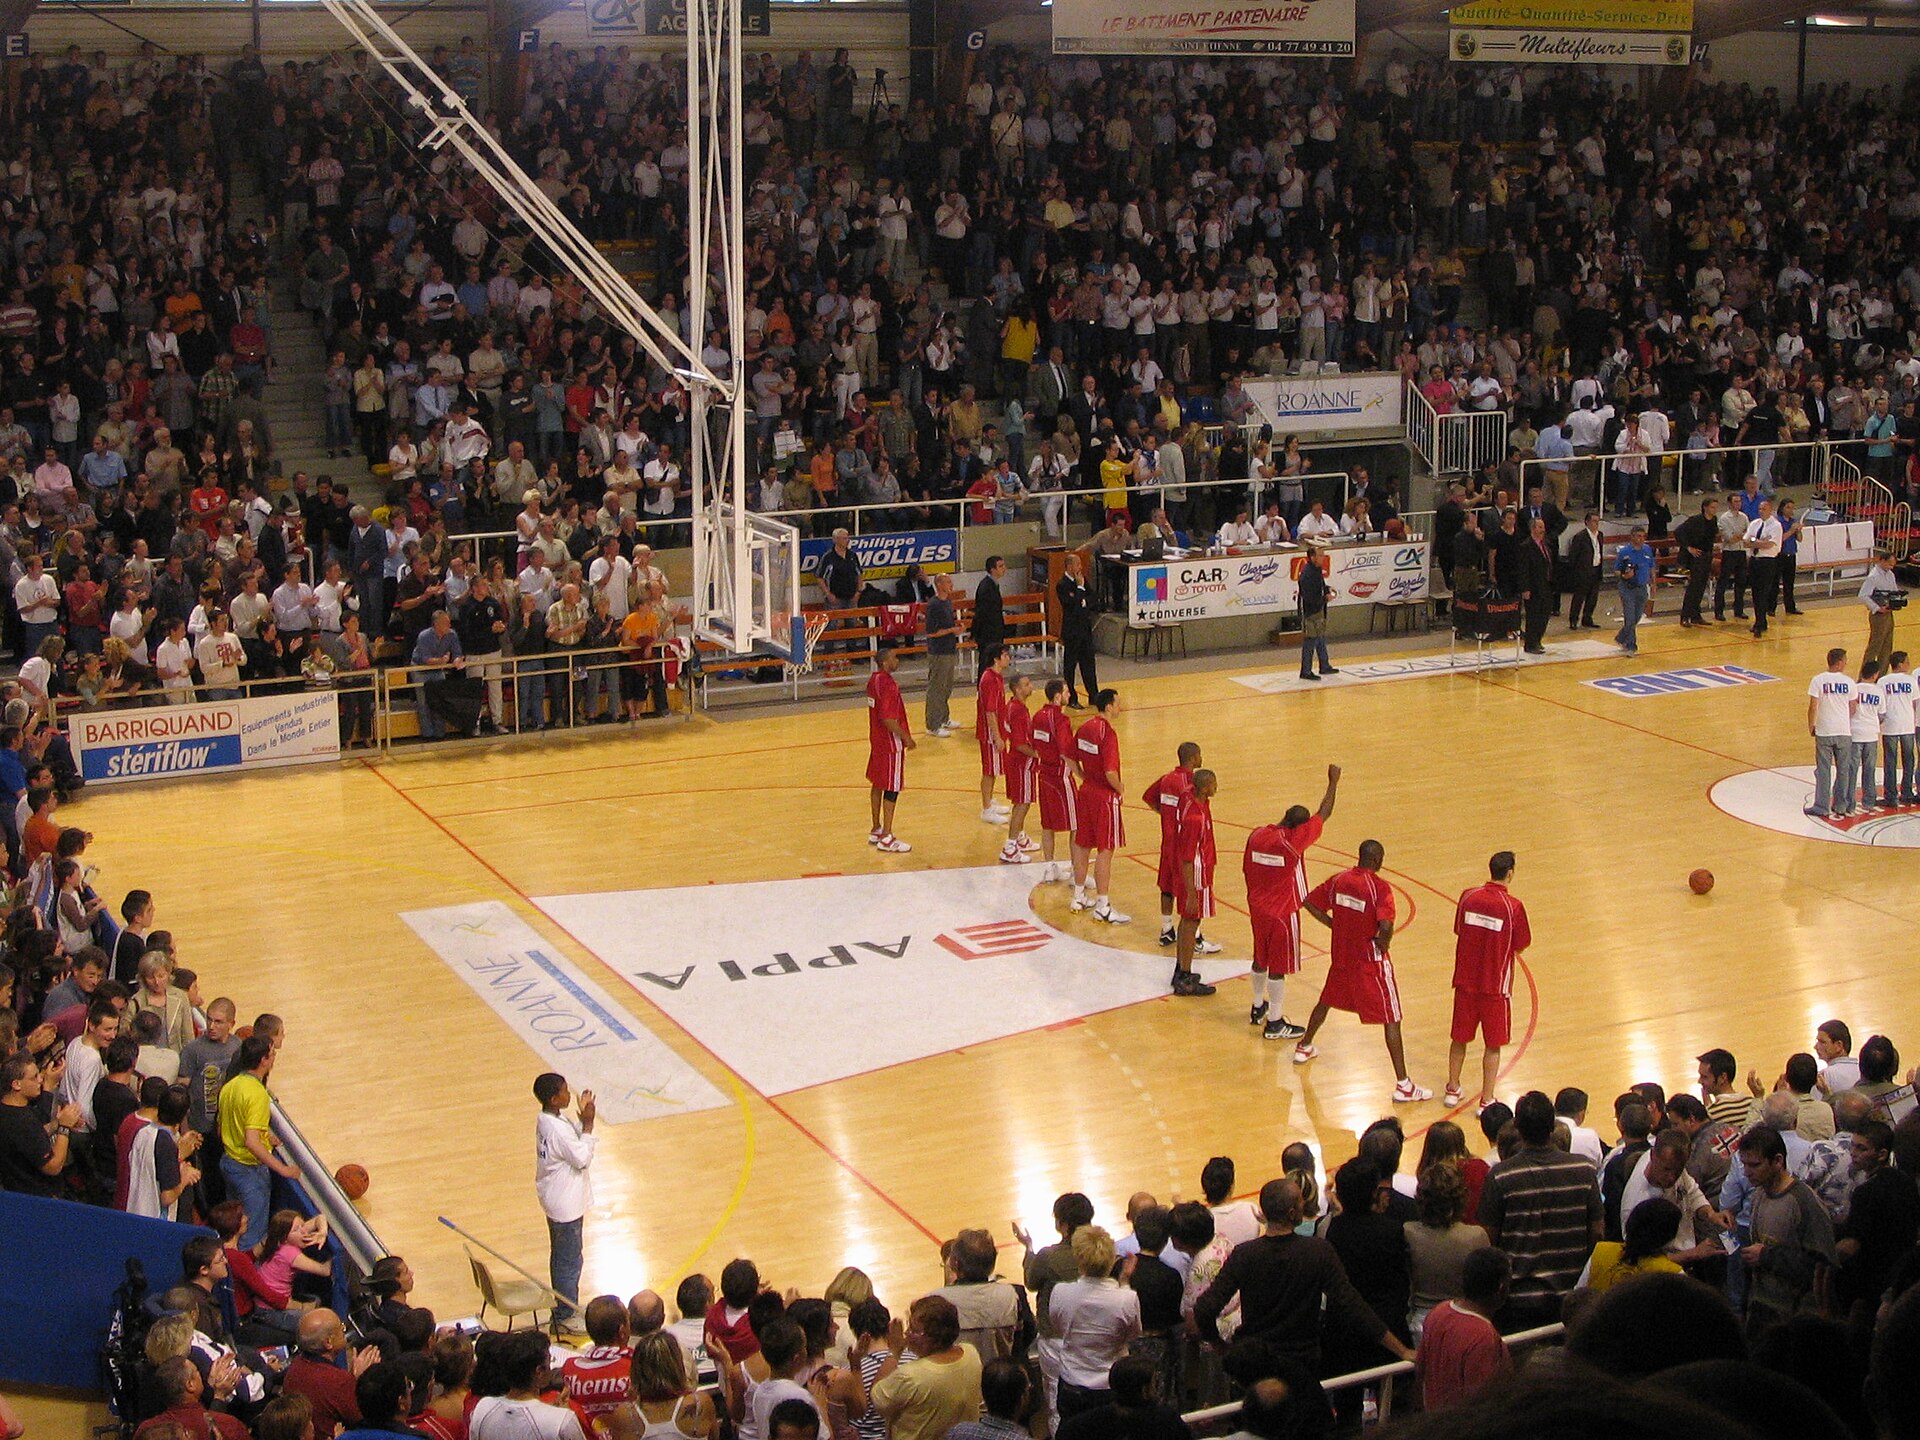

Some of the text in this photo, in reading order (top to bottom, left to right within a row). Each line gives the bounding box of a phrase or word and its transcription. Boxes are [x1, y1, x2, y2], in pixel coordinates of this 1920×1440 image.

[1102, 5, 1310, 33] LE BATIMENT PARTENAIRE
[7, 35, 24, 55] E
[520, 31, 534, 50] F
[967, 31, 984, 49] G
[1268, 42, 1282, 51] 04
[1286, 42, 1299, 51] 77
[1302, 42, 1317, 51] 49
[1337, 43, 1350, 52] 20
[1519, 34, 1626, 60] Multifleurs
[1692, 44, 1707, 60] H
[1278, 390, 1361, 410] ROANNE
[848, 536, 915, 549] Philippe
[801, 544, 952, 571] DMOLLES
[1351, 555, 1382, 566] LOIRE
[1181, 568, 1222, 584] C.A.R
[1192, 584, 1226, 594] TOYOTA
[1149, 606, 1206, 619] CONVERSE
[1593, 669, 1743, 695] LNB
[1829, 683, 1849, 694] LNB
[1892, 683, 1912, 693] LNB
[1861, 693, 1880, 705] LNB
[242, 693, 335, 734] Equipements Industriels
[86, 712, 232, 743] BARRIQUAND
[275, 717, 303, 733] Vendus
[247, 743, 267, 756] Dans
[280, 728, 306, 743] Monde
[308, 718, 331, 733] Entier
[107, 742, 210, 776] stériflow
[633, 935, 911, 991] APPIA
[465, 954, 608, 1051] ROANNE
